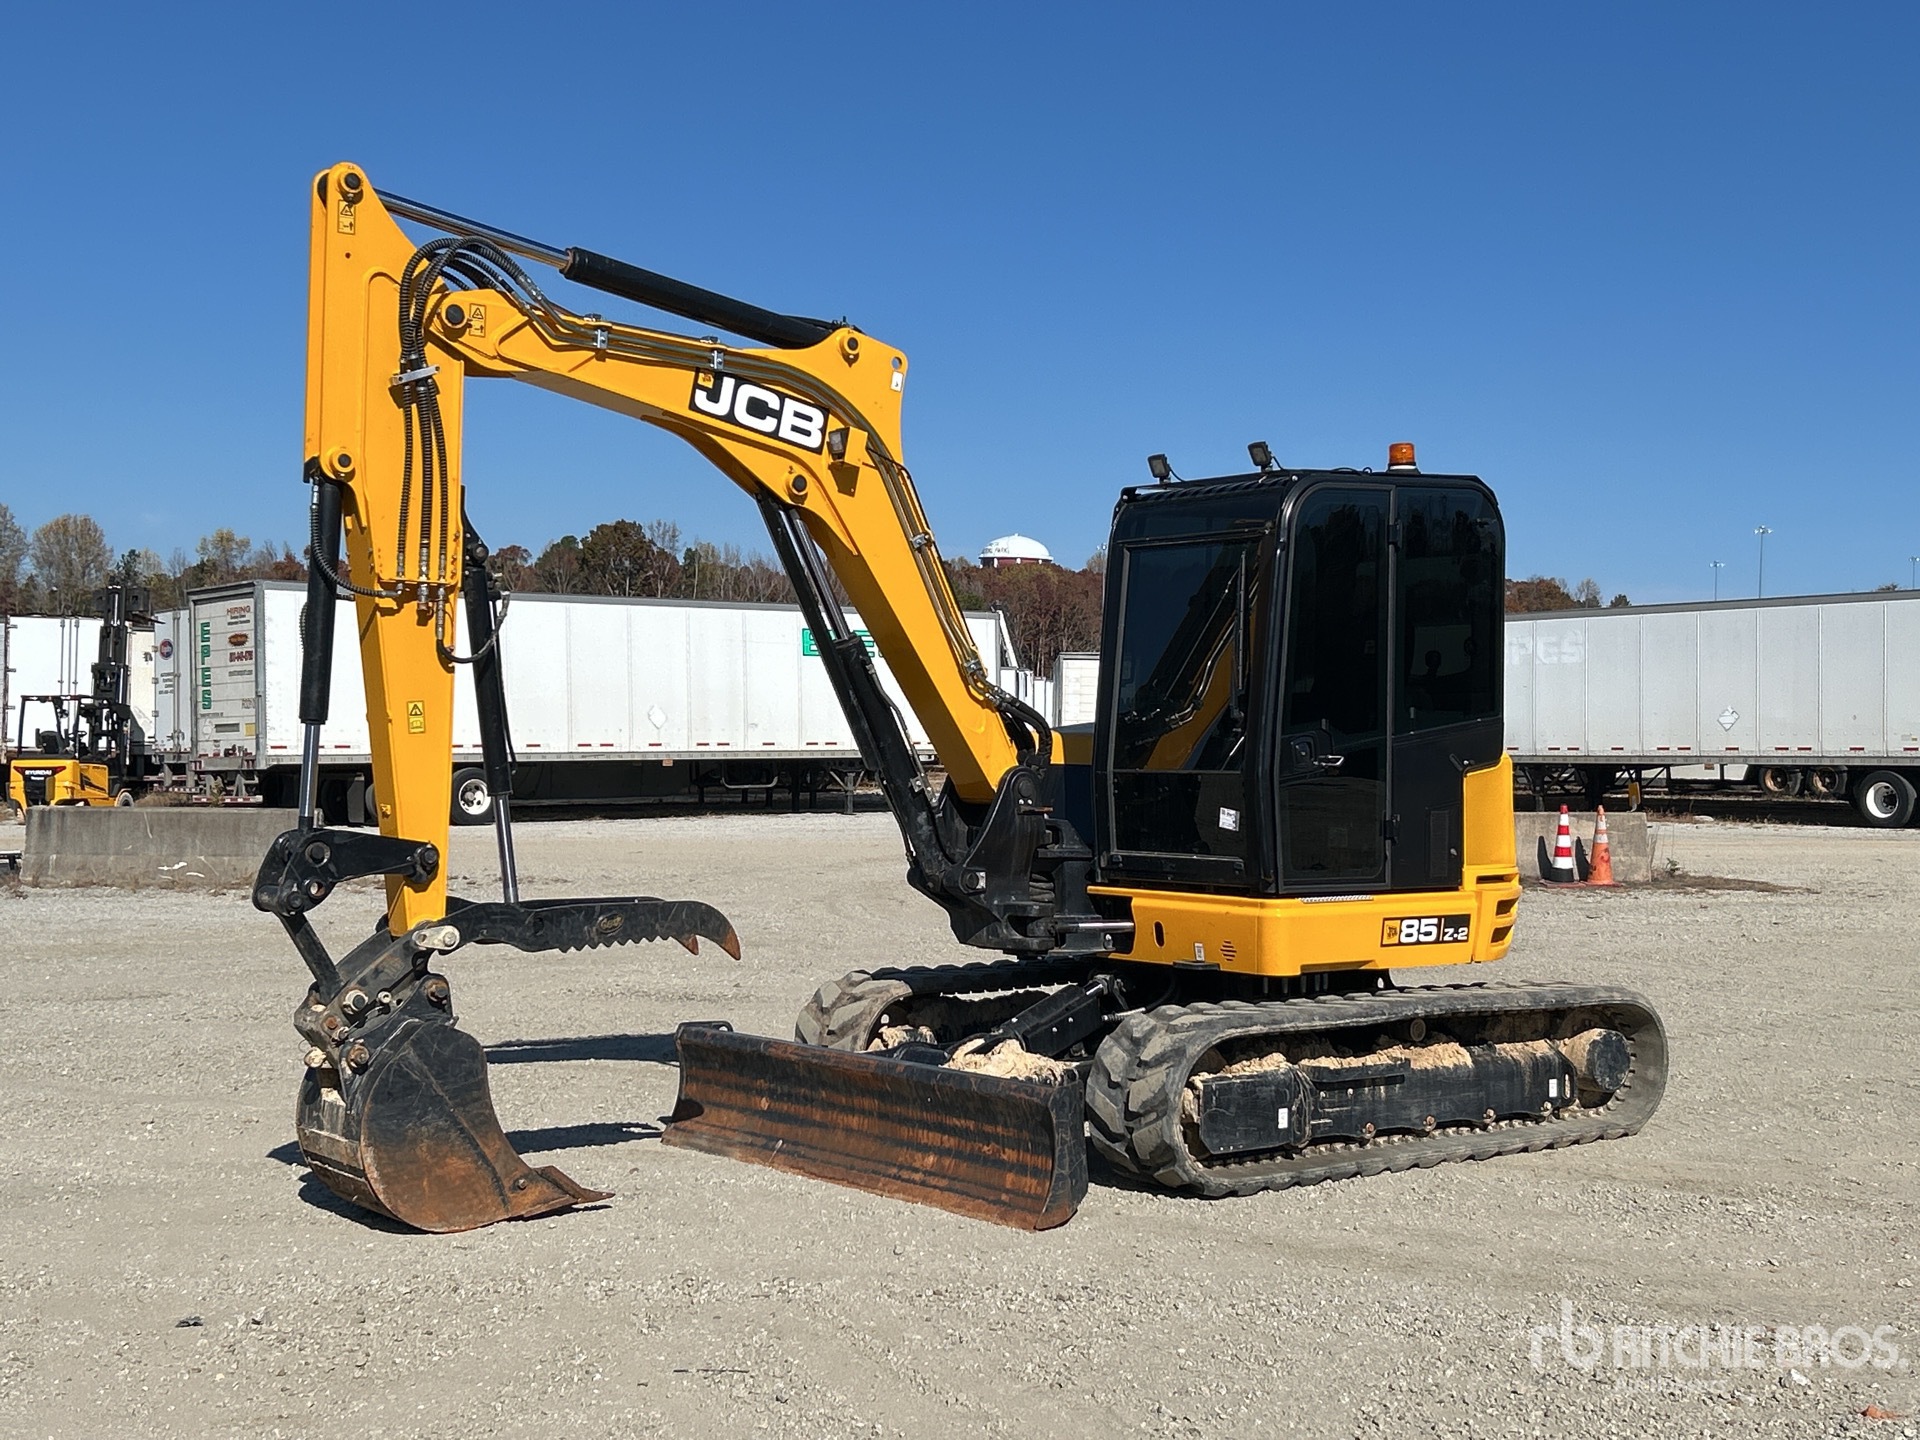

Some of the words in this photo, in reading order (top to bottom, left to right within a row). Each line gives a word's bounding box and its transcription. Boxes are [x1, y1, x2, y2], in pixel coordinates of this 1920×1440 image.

[694, 376, 824, 449] JCB
[226, 605, 250, 615] HIRING
[200, 622, 211, 709] EPES
[1399, 917, 1439, 943] 85
